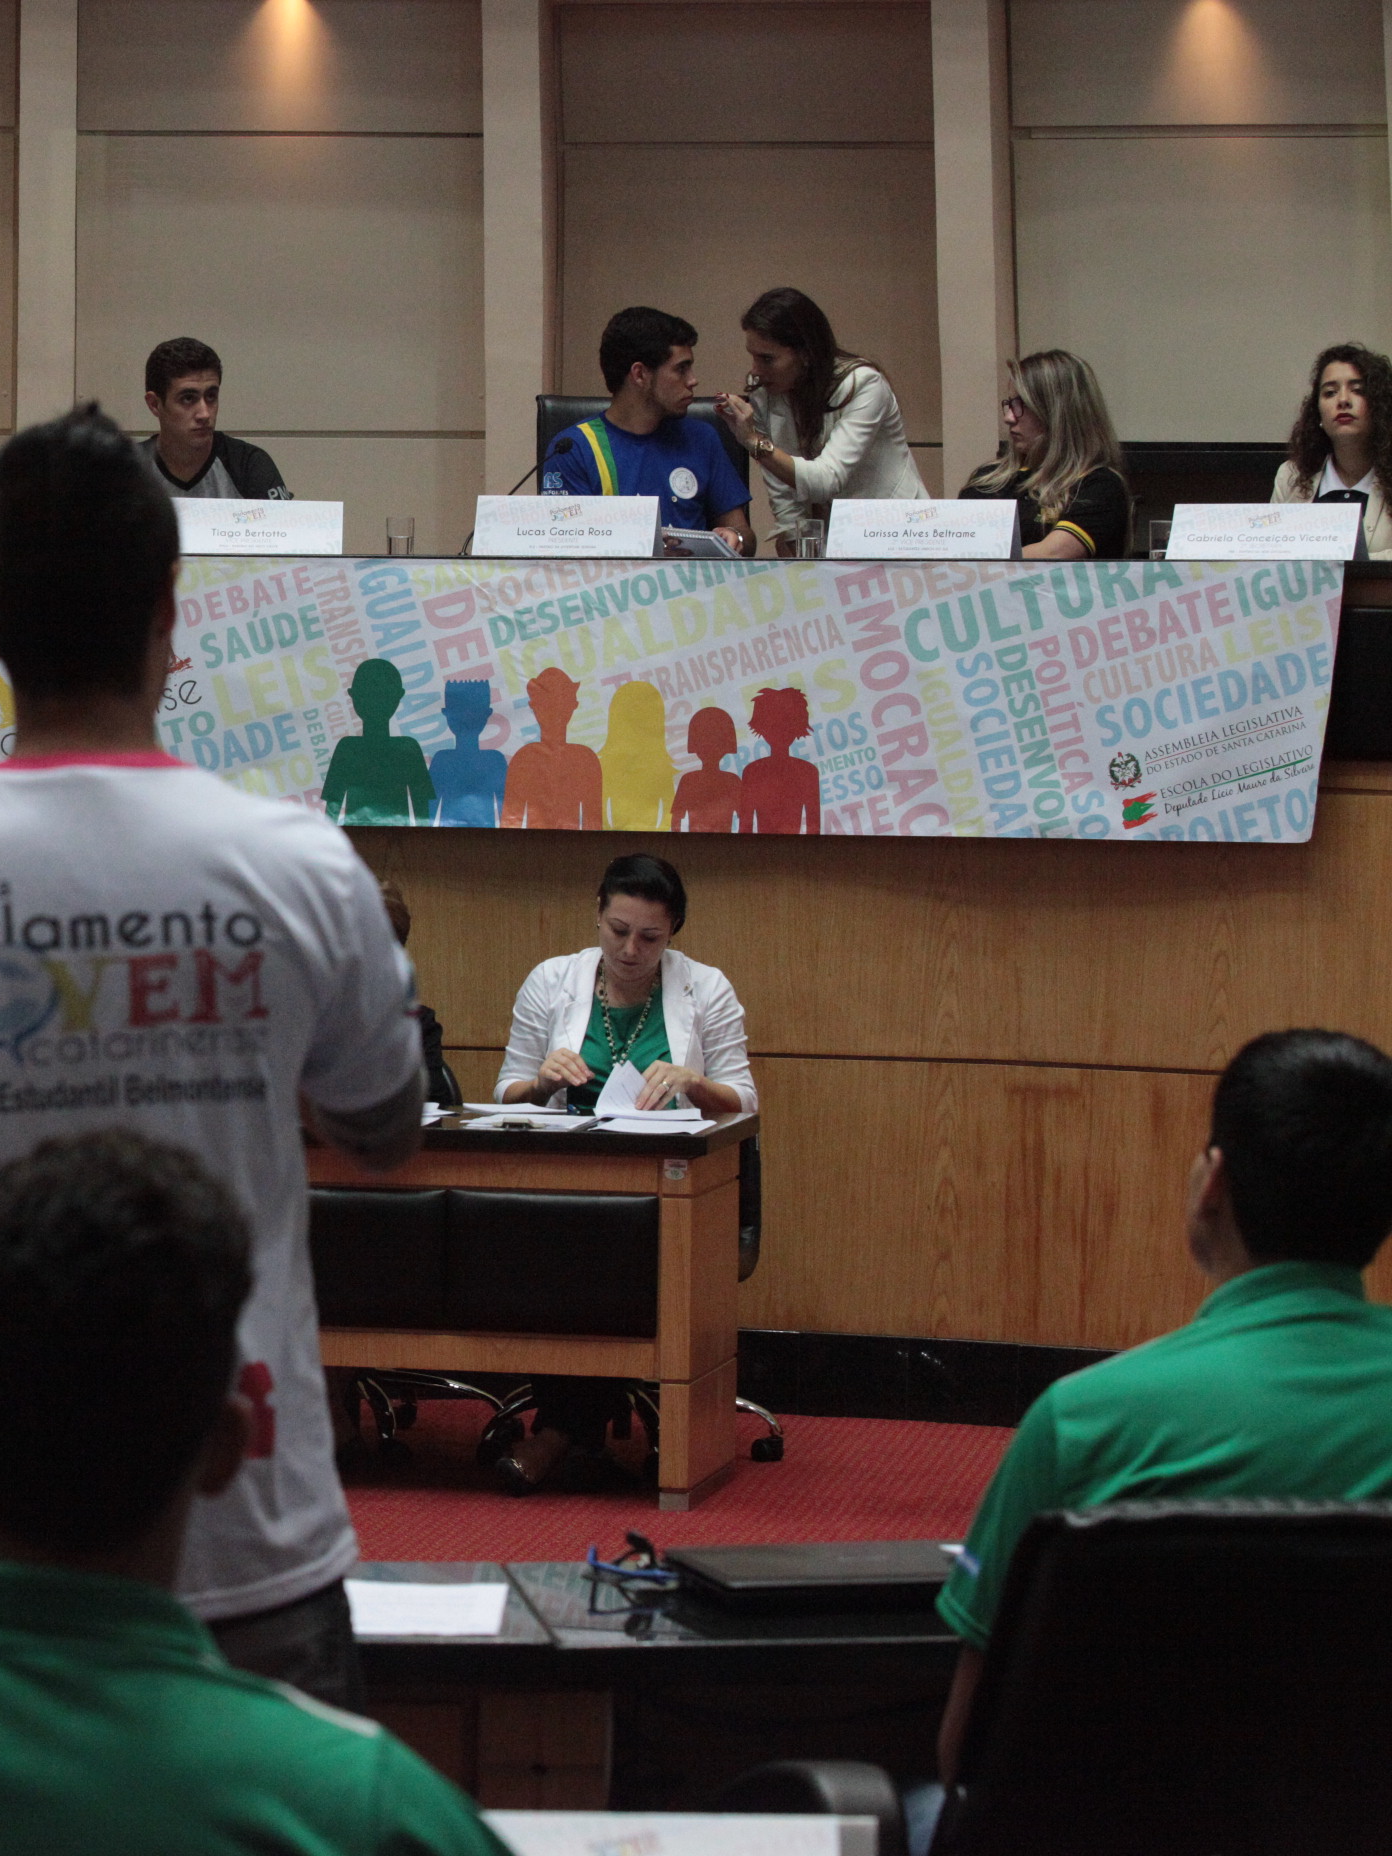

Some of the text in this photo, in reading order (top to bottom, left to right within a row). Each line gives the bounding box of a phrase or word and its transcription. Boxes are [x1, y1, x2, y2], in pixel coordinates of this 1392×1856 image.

[211, 528, 287, 539] Tiago Bertotto
[516, 527, 612, 537] Lucas Garcia Rosa
[863, 528, 976, 538] Larissa Alves Beltrame
[1187, 533, 1339, 544] Gabriela Conceição Vicente
[180, 565, 314, 628] DEBATE
[904, 561, 1184, 663] CULTURA
[1067, 581, 1236, 671] DEBATE
[199, 603, 324, 669] SAÚDE
[639, 614, 846, 701] TRANSPARÊNCIA
[1222, 604, 1325, 665] LEIS
[212, 644, 341, 727] LEIS
[1083, 637, 1220, 705] CULTURA
[1095, 642, 1331, 747] SOCIEDADE
[956, 651, 1033, 838] SOCIEDA
[1028, 635, 1095, 796] POLÍTICA
[1144, 705, 1303, 762] ASSEMBLEIA LEGISLATIVA
[1146, 720, 1307, 775] DO ESTADO DE SANTA CATARINA
[1159, 744, 1314, 799] ESCOLA DO LEGISLATIVO
[1164, 792, 1208, 817] Deputado
[1269, 770, 1282, 783] da
